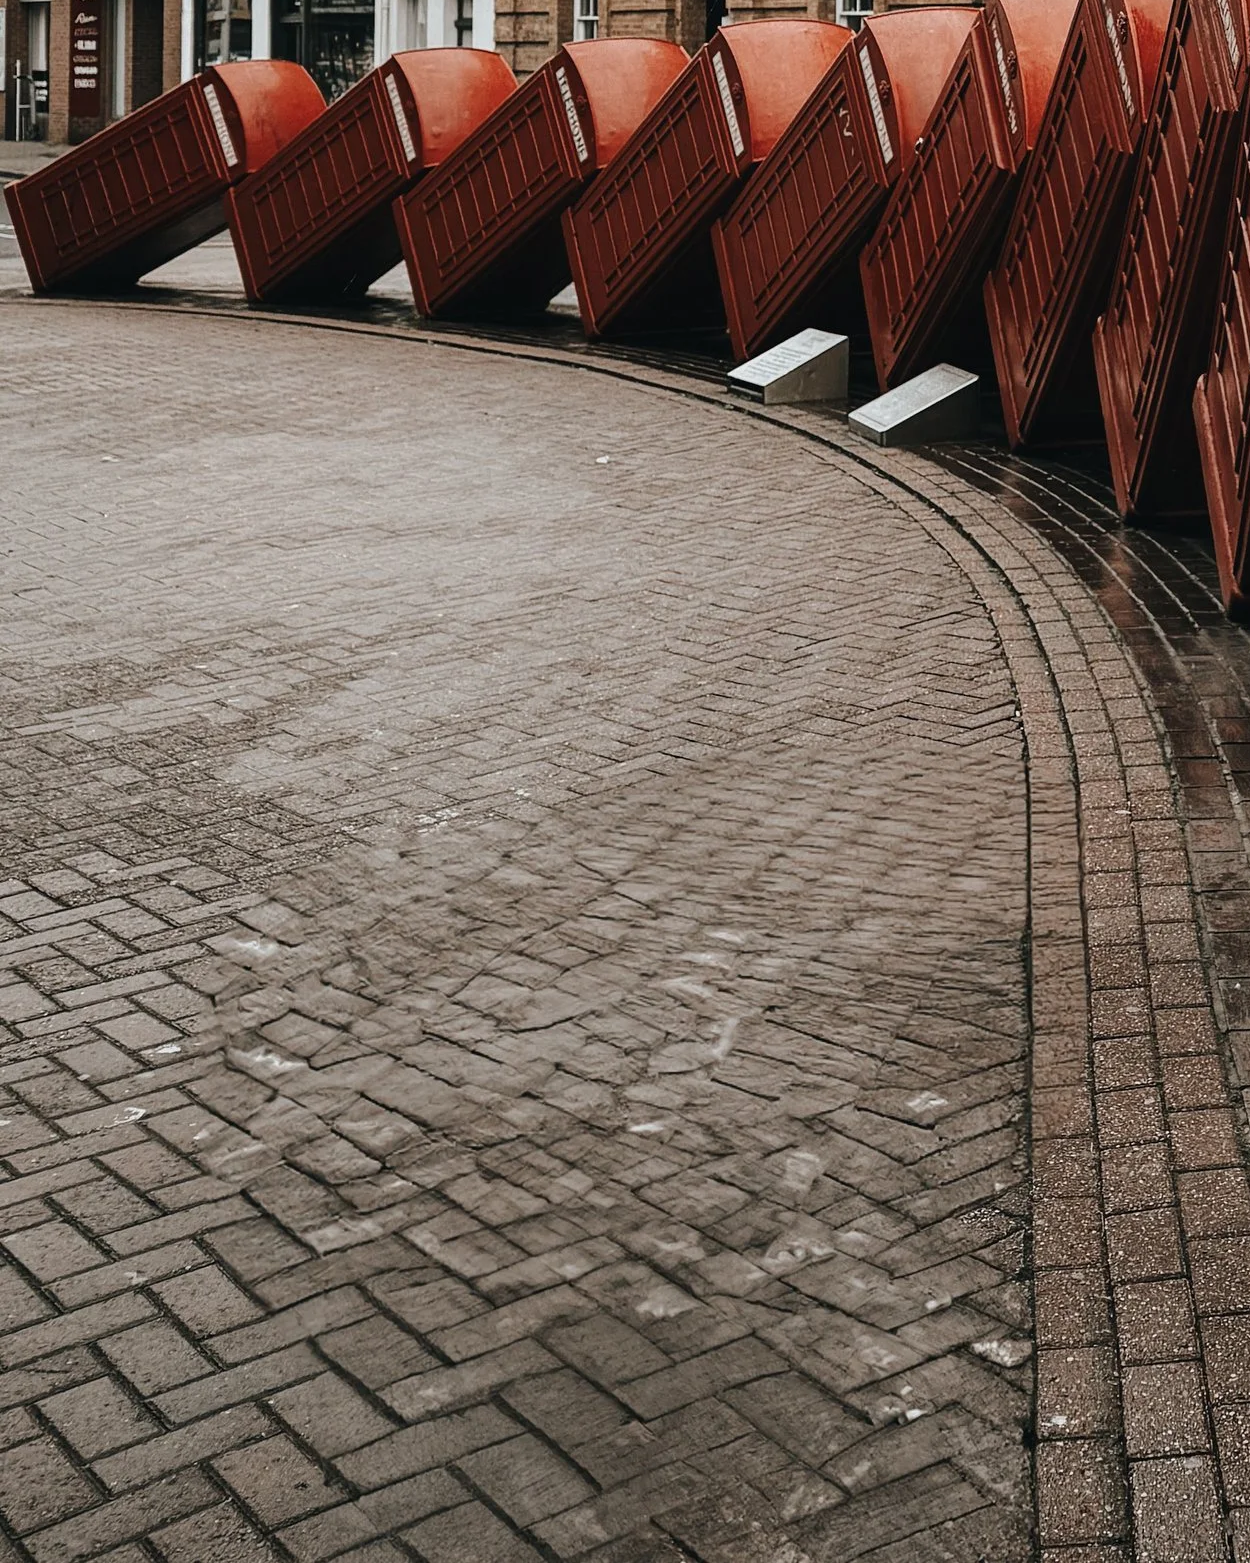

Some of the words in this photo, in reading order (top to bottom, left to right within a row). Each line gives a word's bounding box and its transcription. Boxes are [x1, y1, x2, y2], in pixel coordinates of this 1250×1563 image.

[205, 88, 236, 163] TELEPHONE
[387, 80, 415, 158] TELEPHONE
[557, 72, 587, 160] TELEPHONE
[713, 57, 742, 151] TELEPHONE
[861, 49, 892, 158] TELEPHONE
